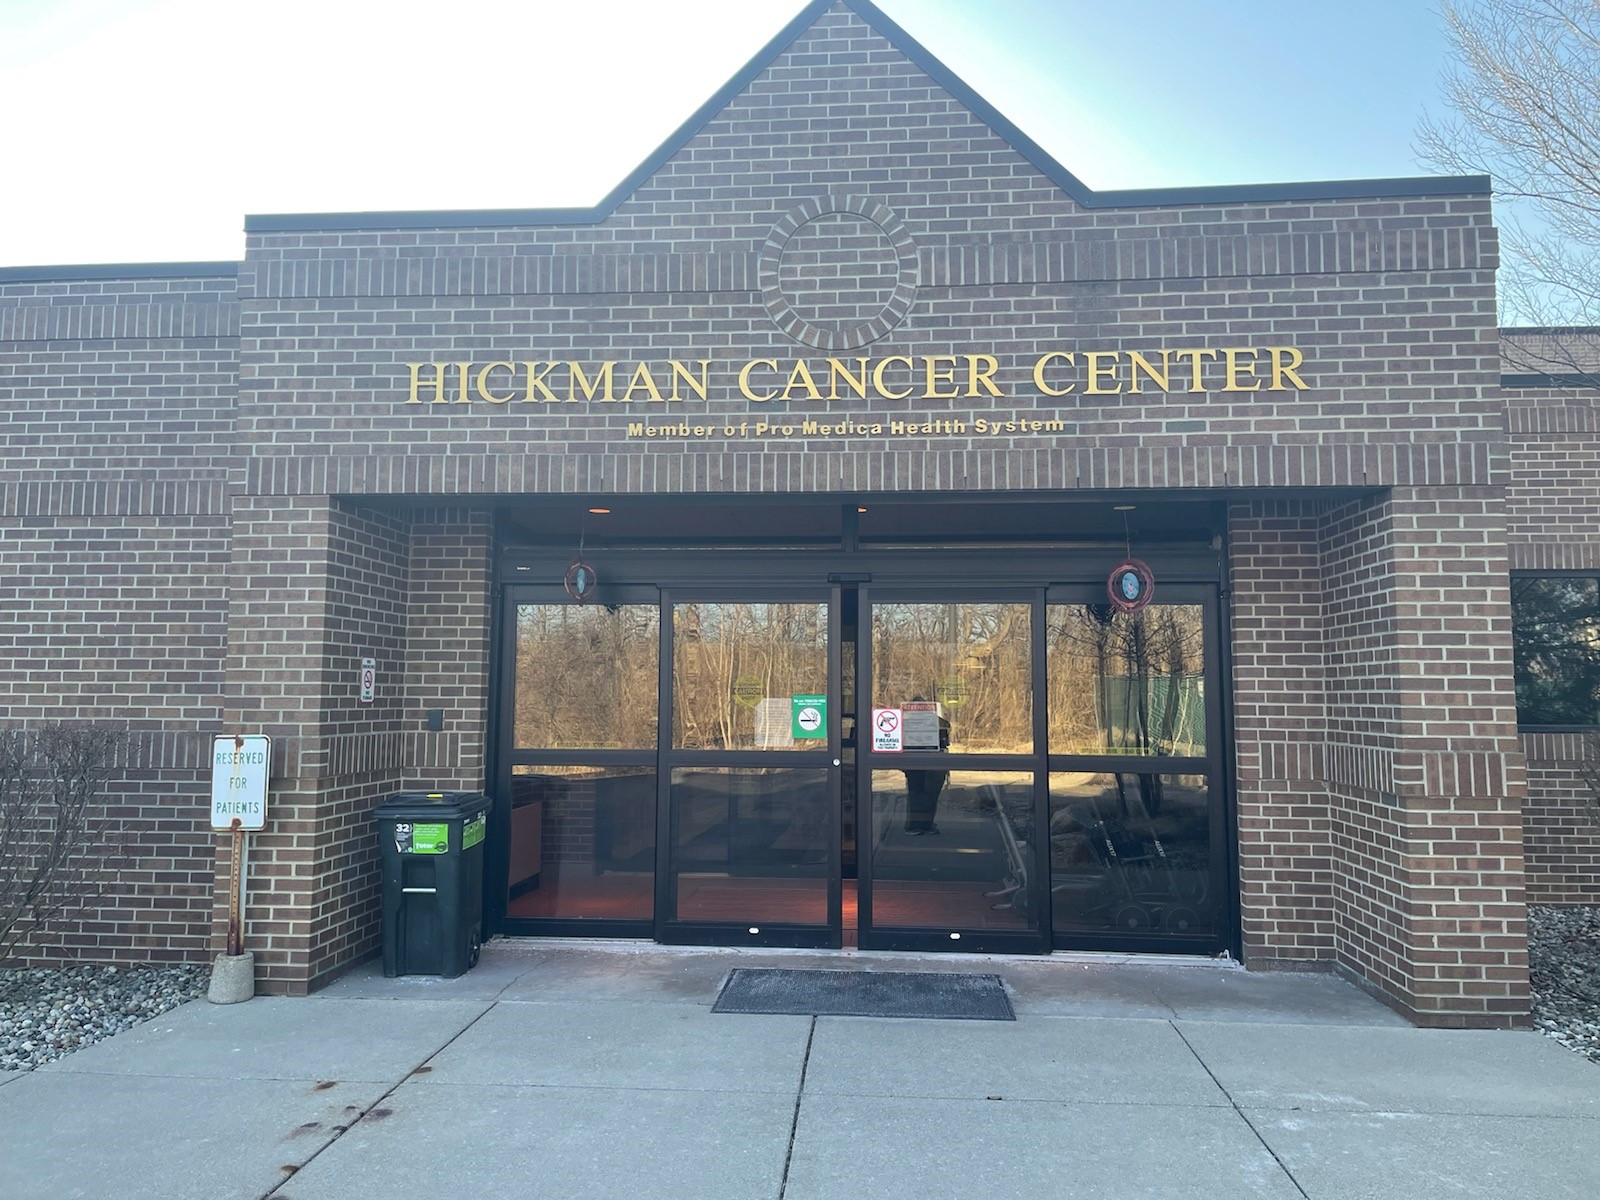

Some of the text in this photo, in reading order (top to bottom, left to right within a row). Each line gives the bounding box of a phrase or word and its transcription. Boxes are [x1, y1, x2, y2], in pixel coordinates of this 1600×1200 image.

[404, 346, 1311, 405] HICKMAN CANCER CENTER
[628, 418, 1065, 438] Member of Pro Medica Health System
[215, 752, 264, 765] RESERVED
[229, 777, 248, 790] FOR
[215, 801, 260, 814] PATIENTS
[395, 823, 410, 833] 32
